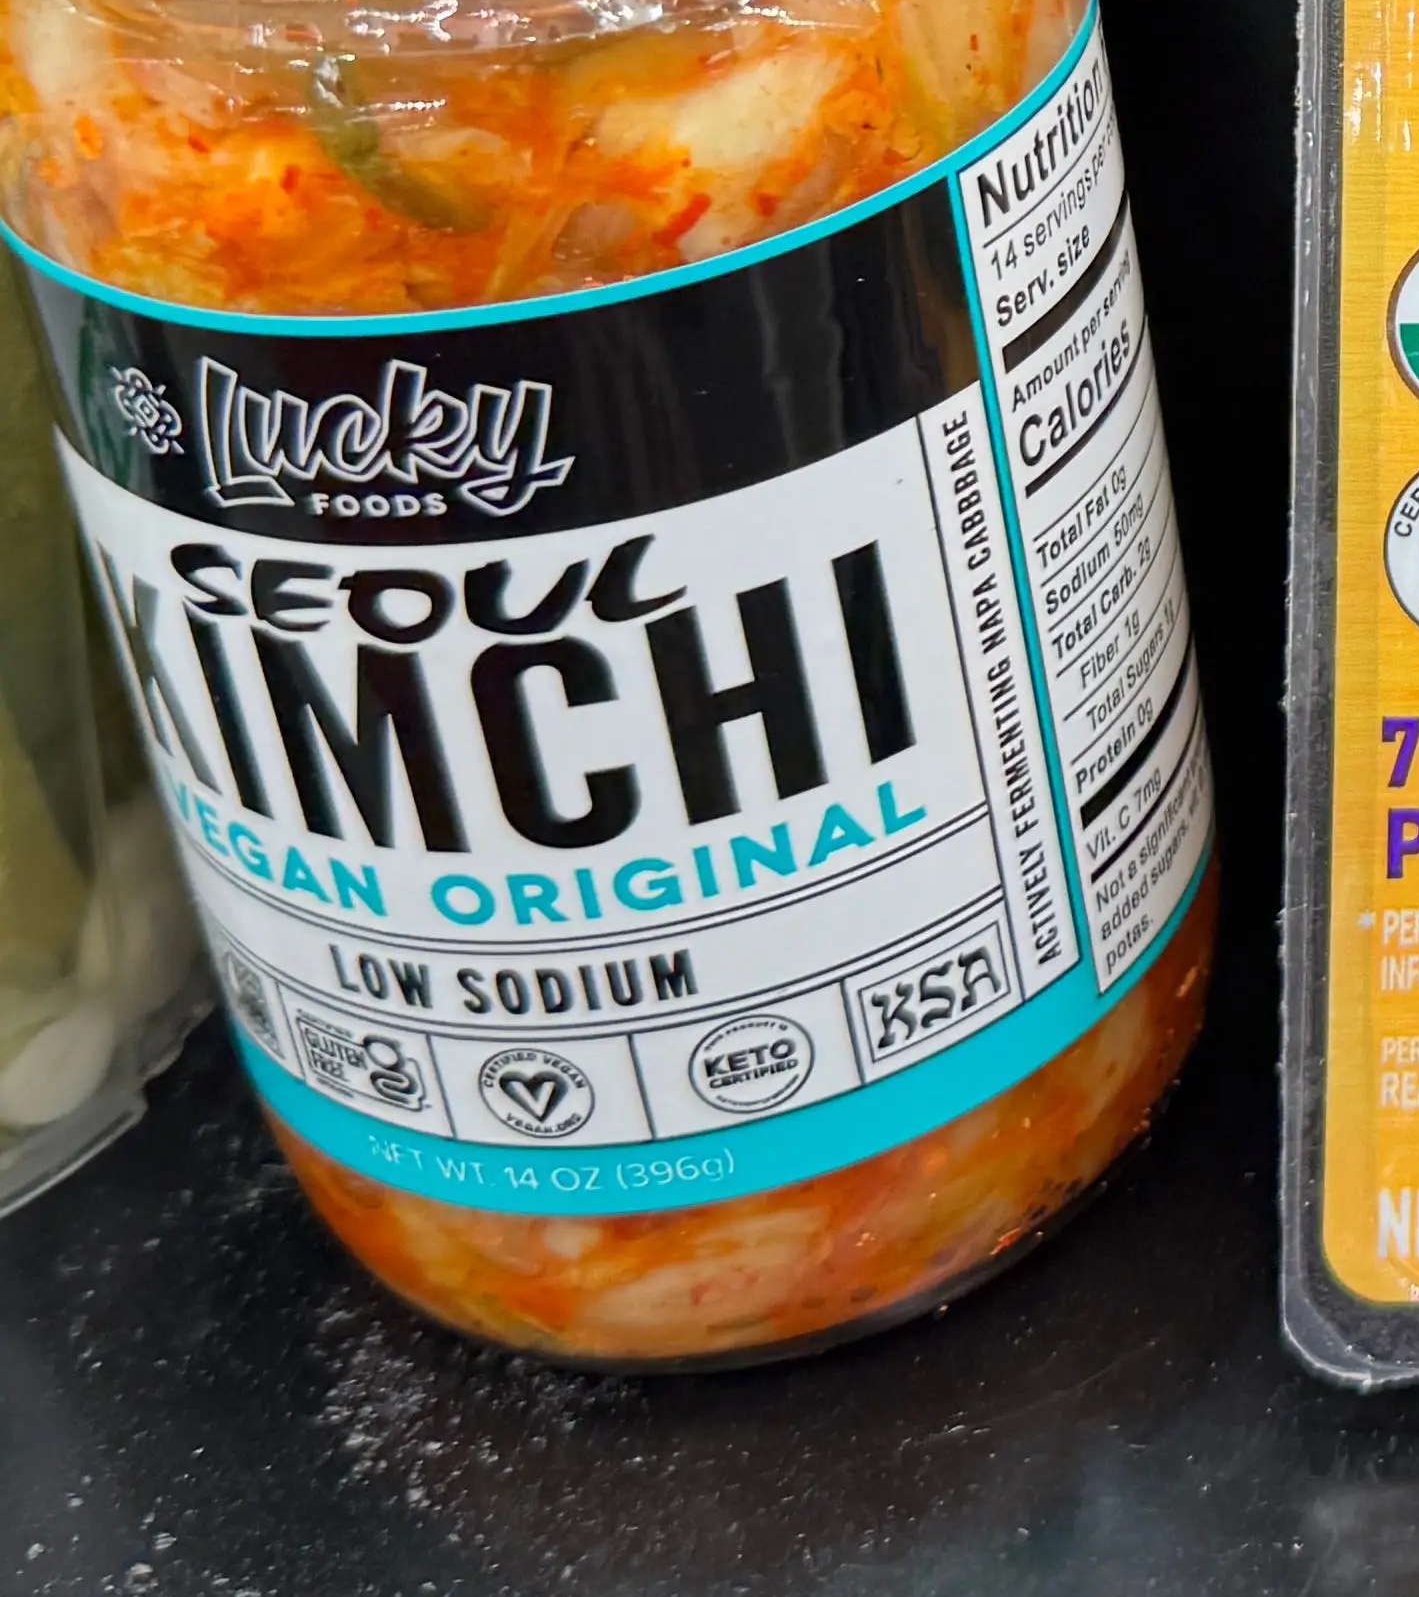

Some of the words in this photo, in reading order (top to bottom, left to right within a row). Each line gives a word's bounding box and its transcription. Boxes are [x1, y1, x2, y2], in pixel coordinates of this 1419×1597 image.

[977, 58, 1105, 230] Nutrition
[991, 239, 1018, 281] 14
[1023, 164, 1093, 258] servings
[996, 268, 1055, 328] Serv.
[1058, 223, 1091, 277] size
[1012, 331, 1081, 414] Amount
[1019, 317, 1132, 468] Calories
[199, 355, 576, 517] Lucky
[311, 492, 449, 517] FOODS
[1035, 512, 1084, 570] Total
[1084, 488, 1111, 529] Fat
[171, 534, 687, 644] SEOUL
[1045, 543, 1112, 616] Sodium
[1051, 603, 1099, 660] Total
[1079, 633, 1121, 691] Fiber
[97, 541, 917, 854] KIMCHI
[1086, 676, 1126, 734] Total
[1074, 721, 1137, 796] Protein
[987, 654, 1038, 838] FERMENTING
[1018, 840, 1063, 968] ACTIVELY
[168, 783, 387, 917] VEGAN
[429, 780, 931, 927] ORIGINAL
[1094, 869, 1126, 913] Not
[1101, 879, 1150, 942] added
[328, 943, 434, 1010] LOW
[456, 948, 699, 1016] SODIUM
[1105, 910, 1155, 975] potas.
[703, 1038, 797, 1078] KETO
[707, 1056, 800, 1090] CERTIFIED
[368, 1134, 424, 1171] NET
[504, 1165, 540, 1191] 14
[551, 1165, 604, 1192] OZ
[615, 1149, 736, 1192] (396g)
